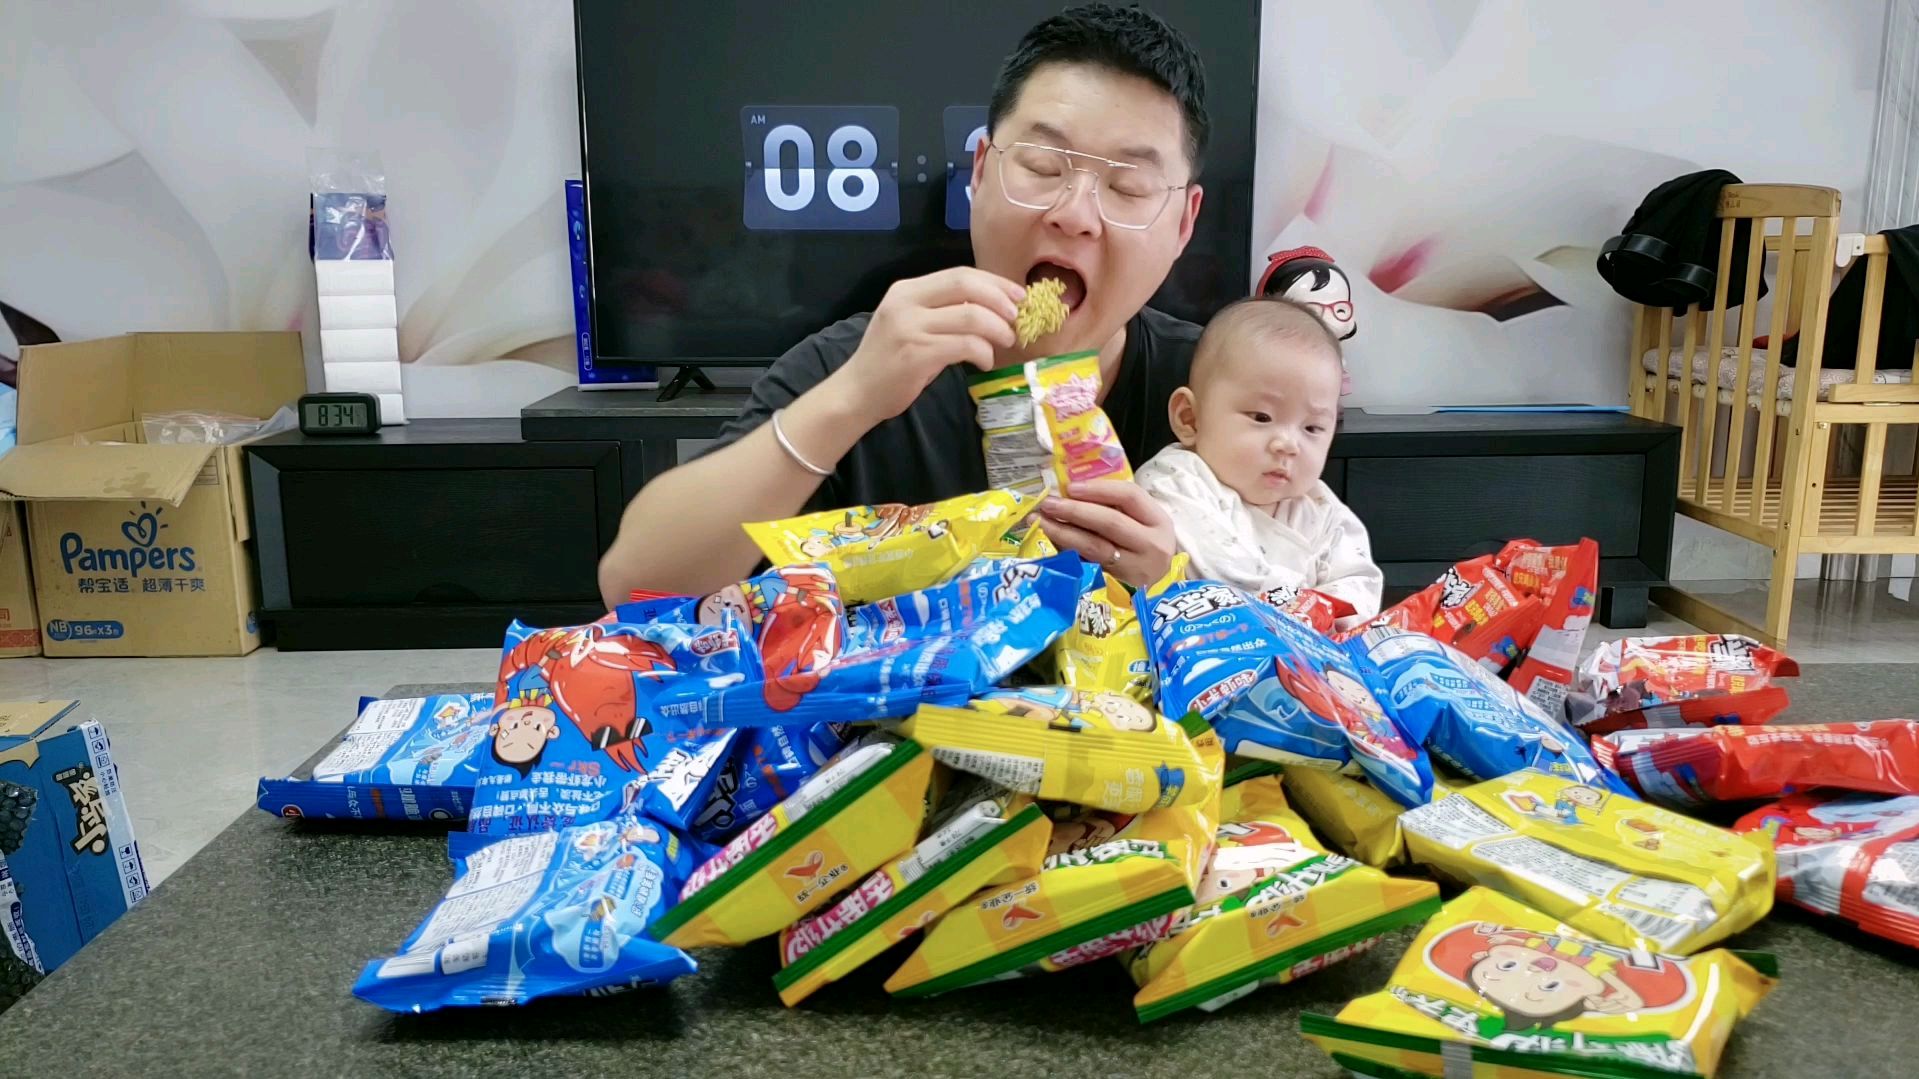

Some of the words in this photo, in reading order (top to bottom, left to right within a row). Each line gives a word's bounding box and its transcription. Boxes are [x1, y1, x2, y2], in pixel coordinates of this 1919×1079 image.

[750, 114, 766, 125] AM
[763, 124, 880, 211] 08
[60, 532, 196, 578] Pampers
[78, 578, 130, 593] 帮宝适
[142, 578, 206, 593] 超薄干爽
[1153, 586, 1245, 632] 小当家
[50, 622, 68, 634] NB
